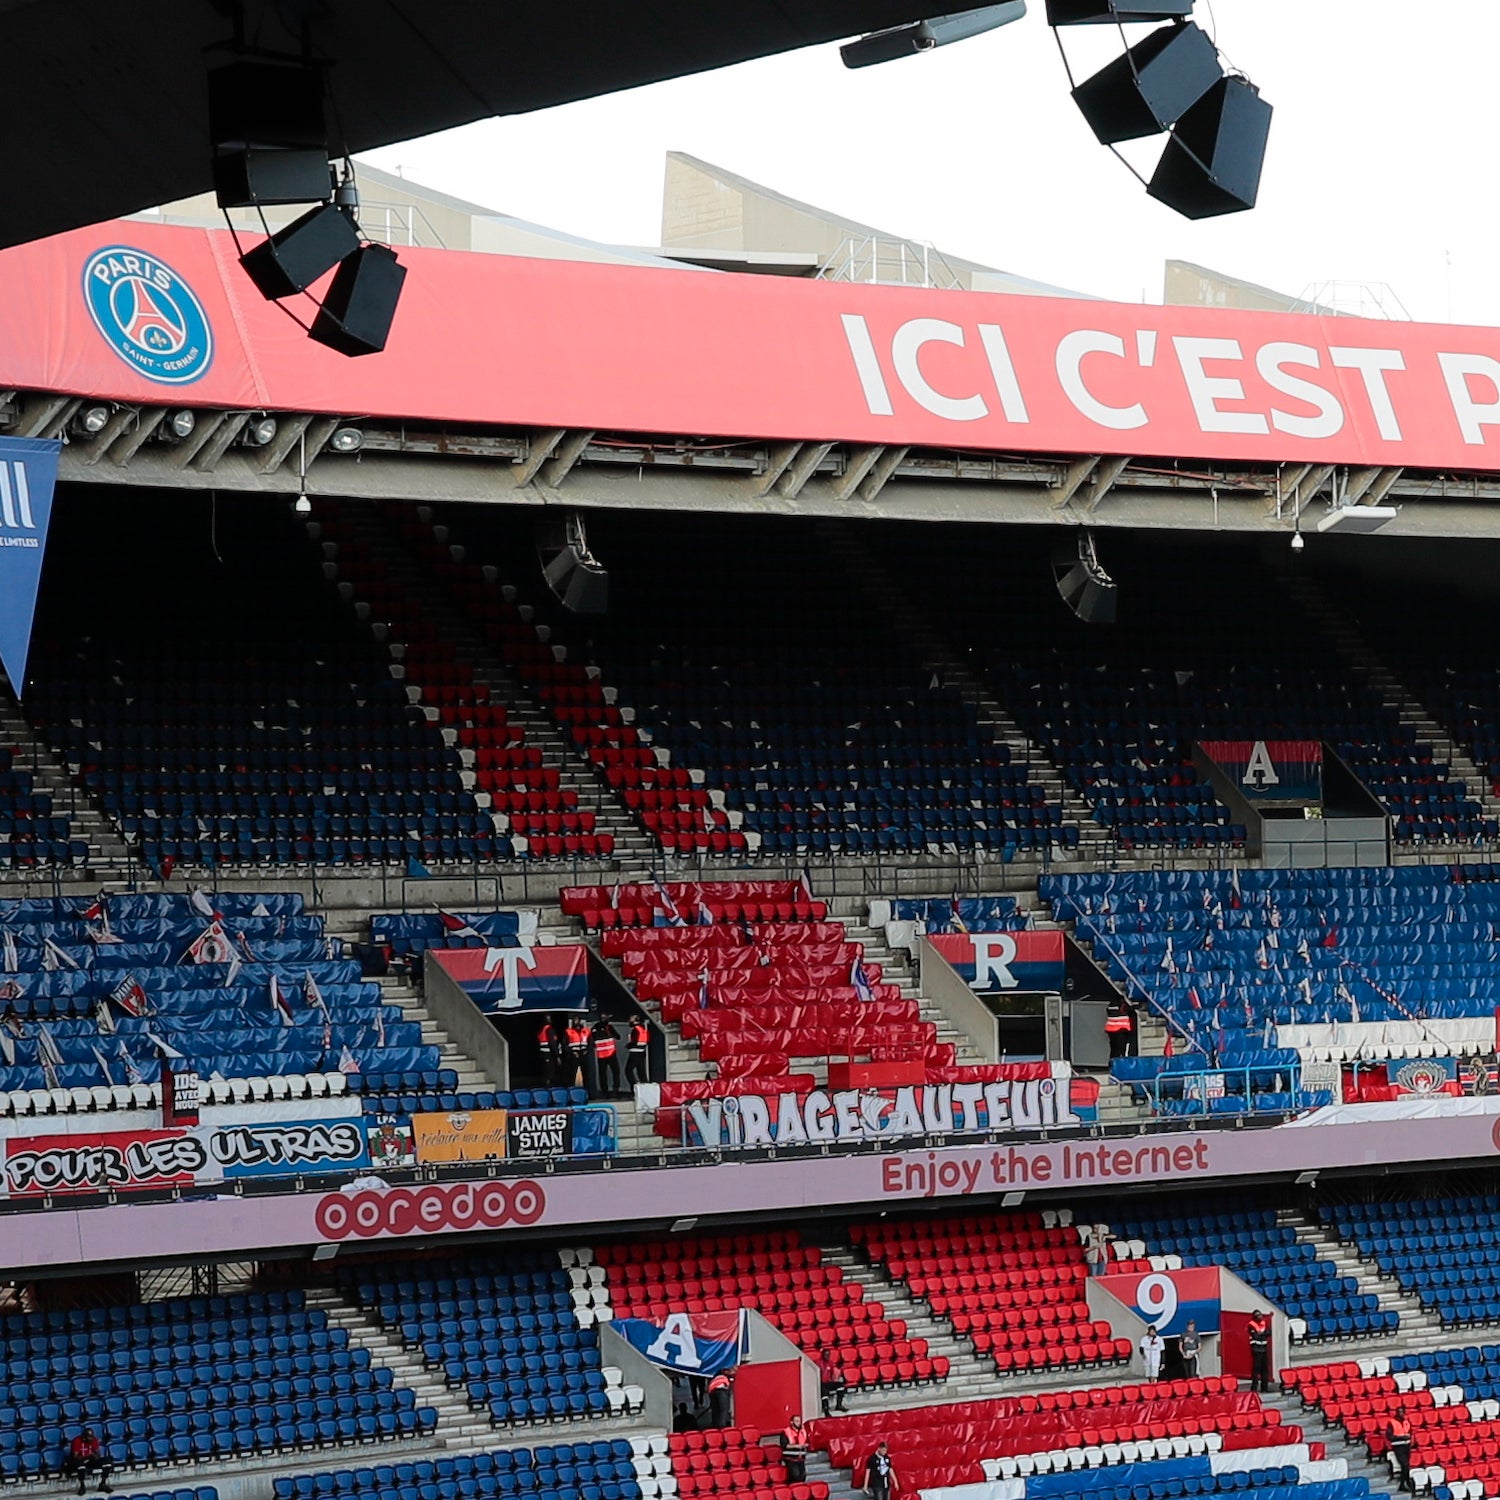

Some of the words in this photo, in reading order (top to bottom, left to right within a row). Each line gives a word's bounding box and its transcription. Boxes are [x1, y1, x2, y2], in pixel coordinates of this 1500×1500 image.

[94, 255, 171, 290] PARIS
[122, 342, 154, 366] SAINT
[841, 314, 1030, 423] ICI
[1055, 330, 1405, 441] C'EST
[1243, 741, 1278, 785] A
[484, 947, 537, 1008] T
[968, 935, 1018, 988] R
[174, 1073, 198, 1091] IDS
[511, 1114, 567, 1136] JAMES
[519, 1131, 563, 1148] STAN
[7, 1149, 129, 1189] POUR
[129, 1137, 205, 1180] LES
[209, 1118, 362, 1166] ULTRAS
[882, 1149, 981, 1197] Enjoy
[992, 1146, 1051, 1186] the
[1063, 1138, 1208, 1180] Internet
[318, 1182, 544, 1239] ooredoo
[1135, 1273, 1177, 1337] 9
[647, 1313, 700, 1367] A
